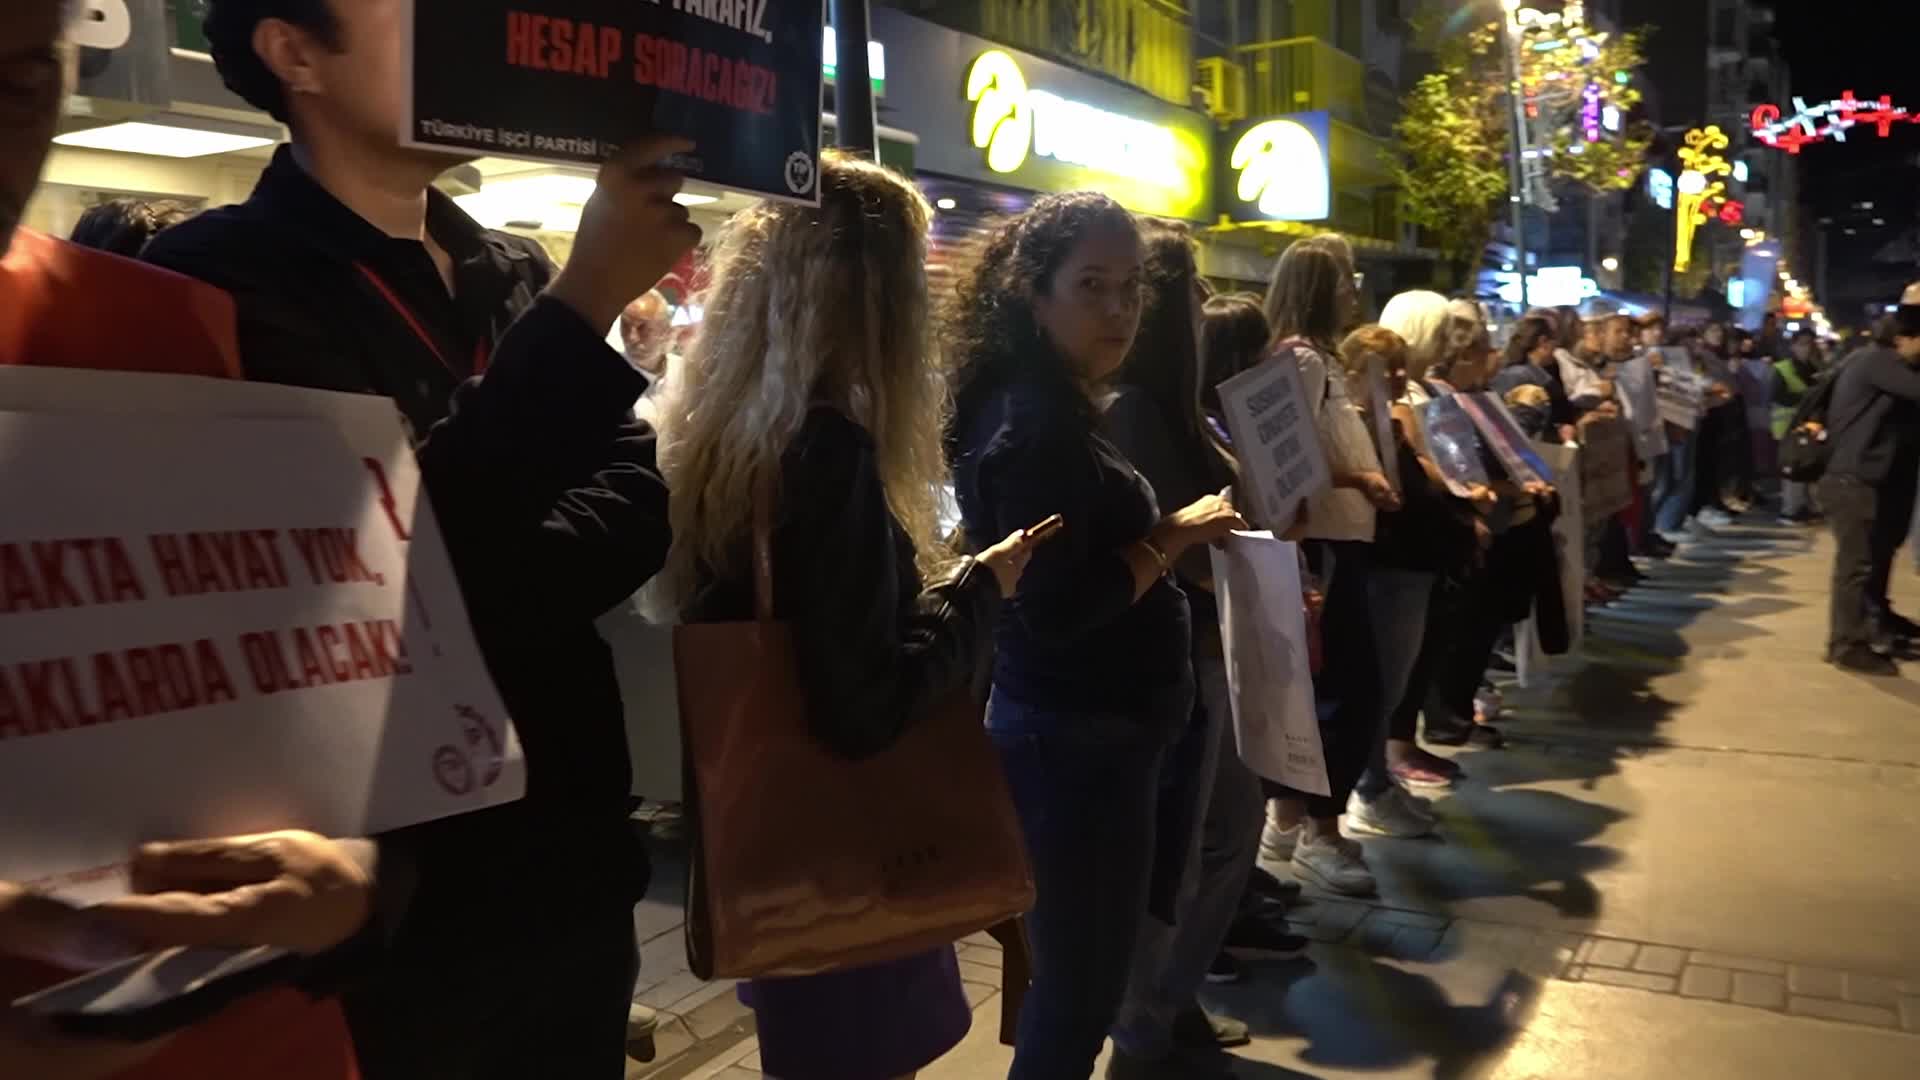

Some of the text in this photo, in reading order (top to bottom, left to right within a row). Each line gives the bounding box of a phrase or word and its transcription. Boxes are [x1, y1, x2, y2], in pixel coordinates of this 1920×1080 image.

[506, 12, 620, 78] HESAP
[672, 0, 772, 44] AFIZ,
[420, 118, 494, 143] TÜRKİYE
[533, 135, 597, 155] PARTİSİ
[0, 526, 386, 613] AKTA HAYAT YOK,
[239, 620, 412, 695] OLACAK!
